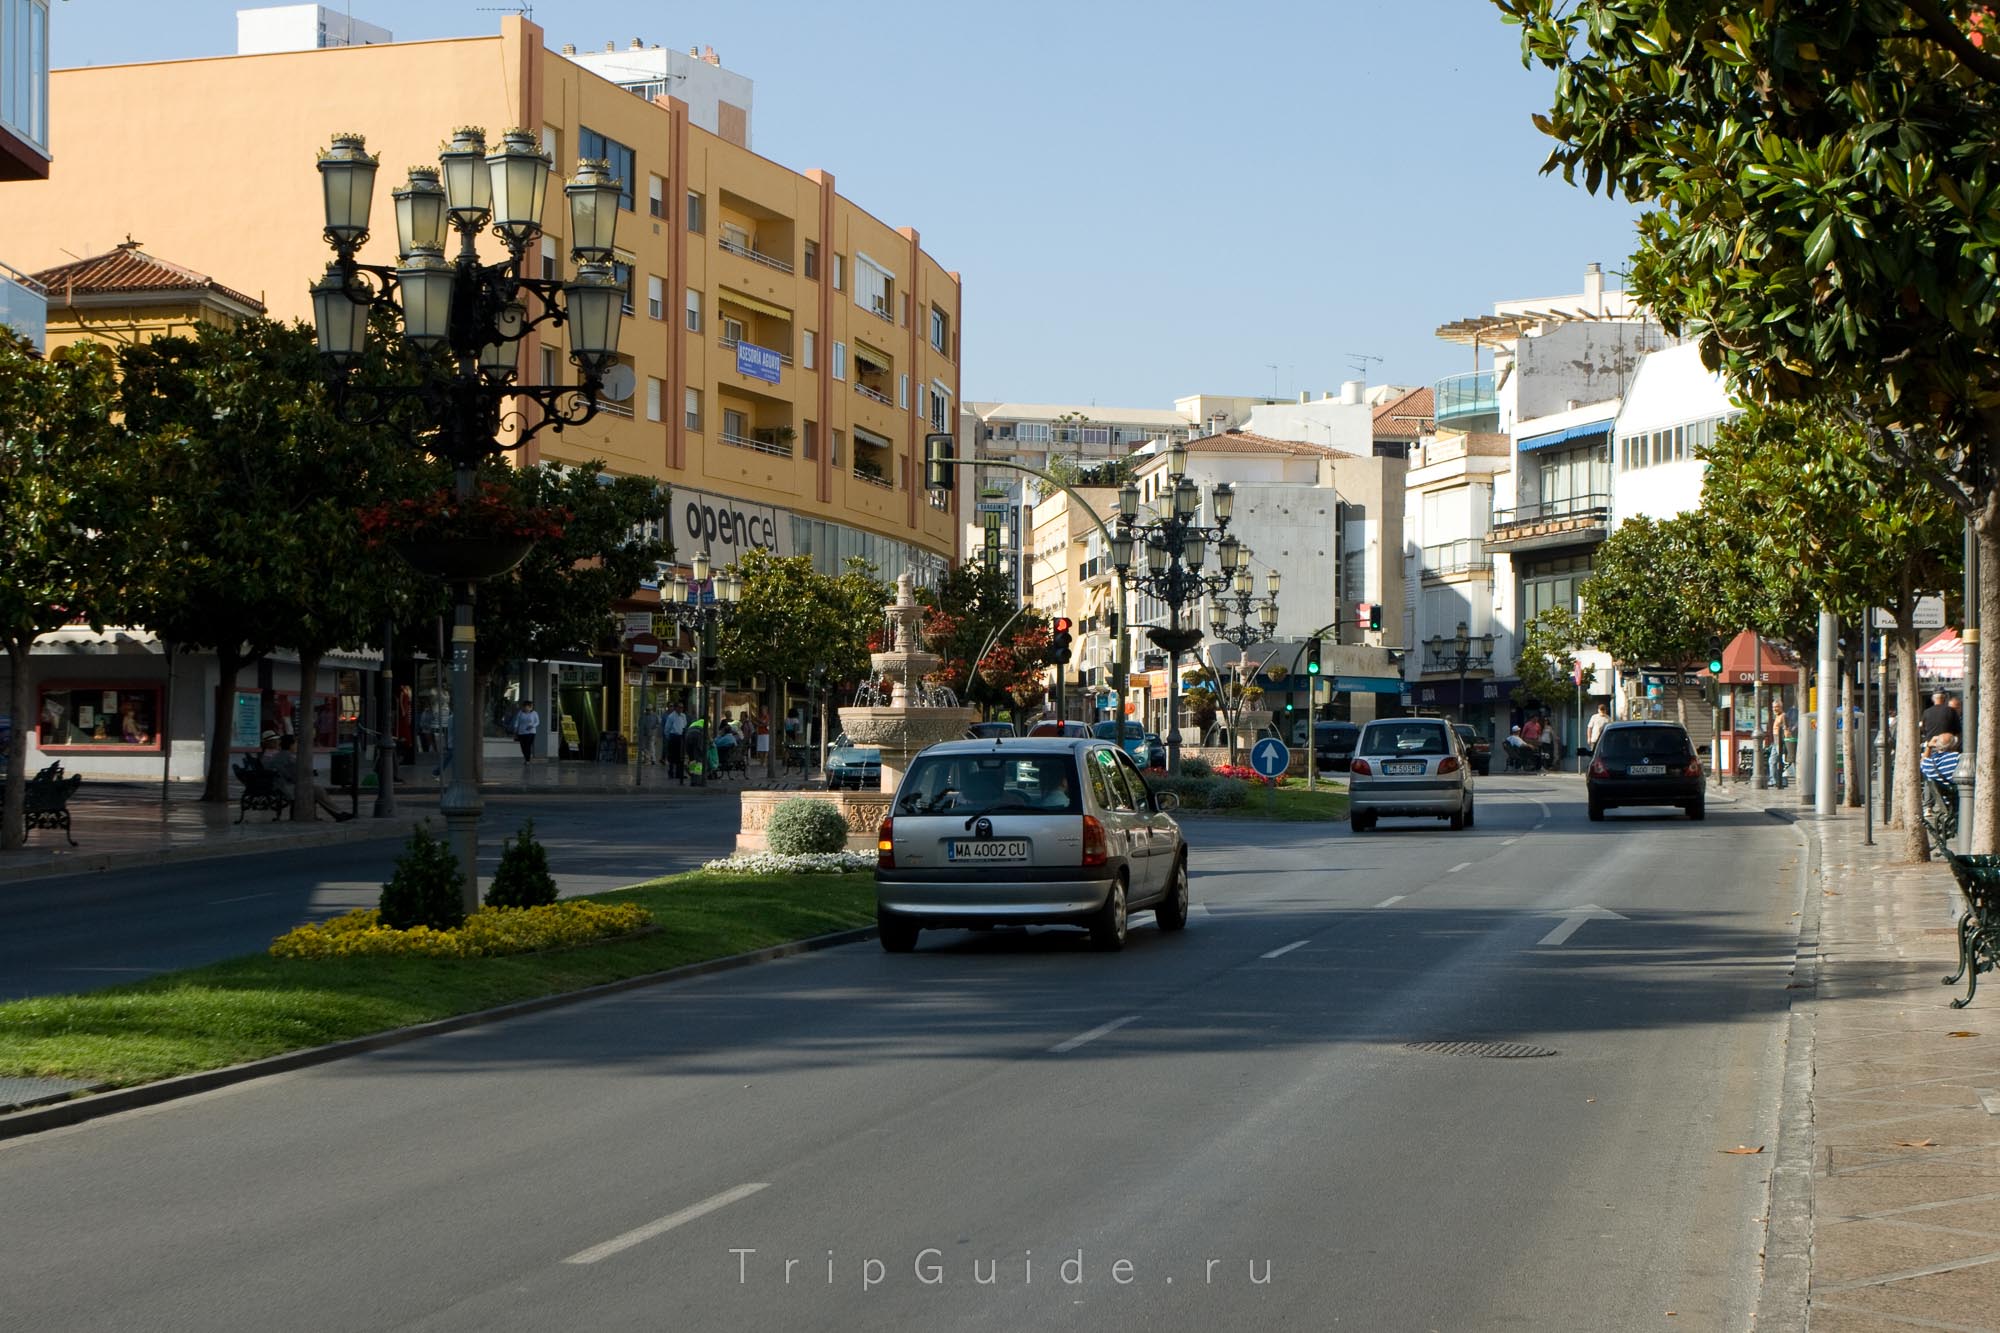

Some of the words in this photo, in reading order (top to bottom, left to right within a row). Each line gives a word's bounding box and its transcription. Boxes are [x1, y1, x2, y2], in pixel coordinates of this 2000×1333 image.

[1739, 672, 1769, 681] ONE
[955, 843, 972, 857] MA
[974, 843, 1006, 857] 4002
[1009, 842, 1025, 856] CU
